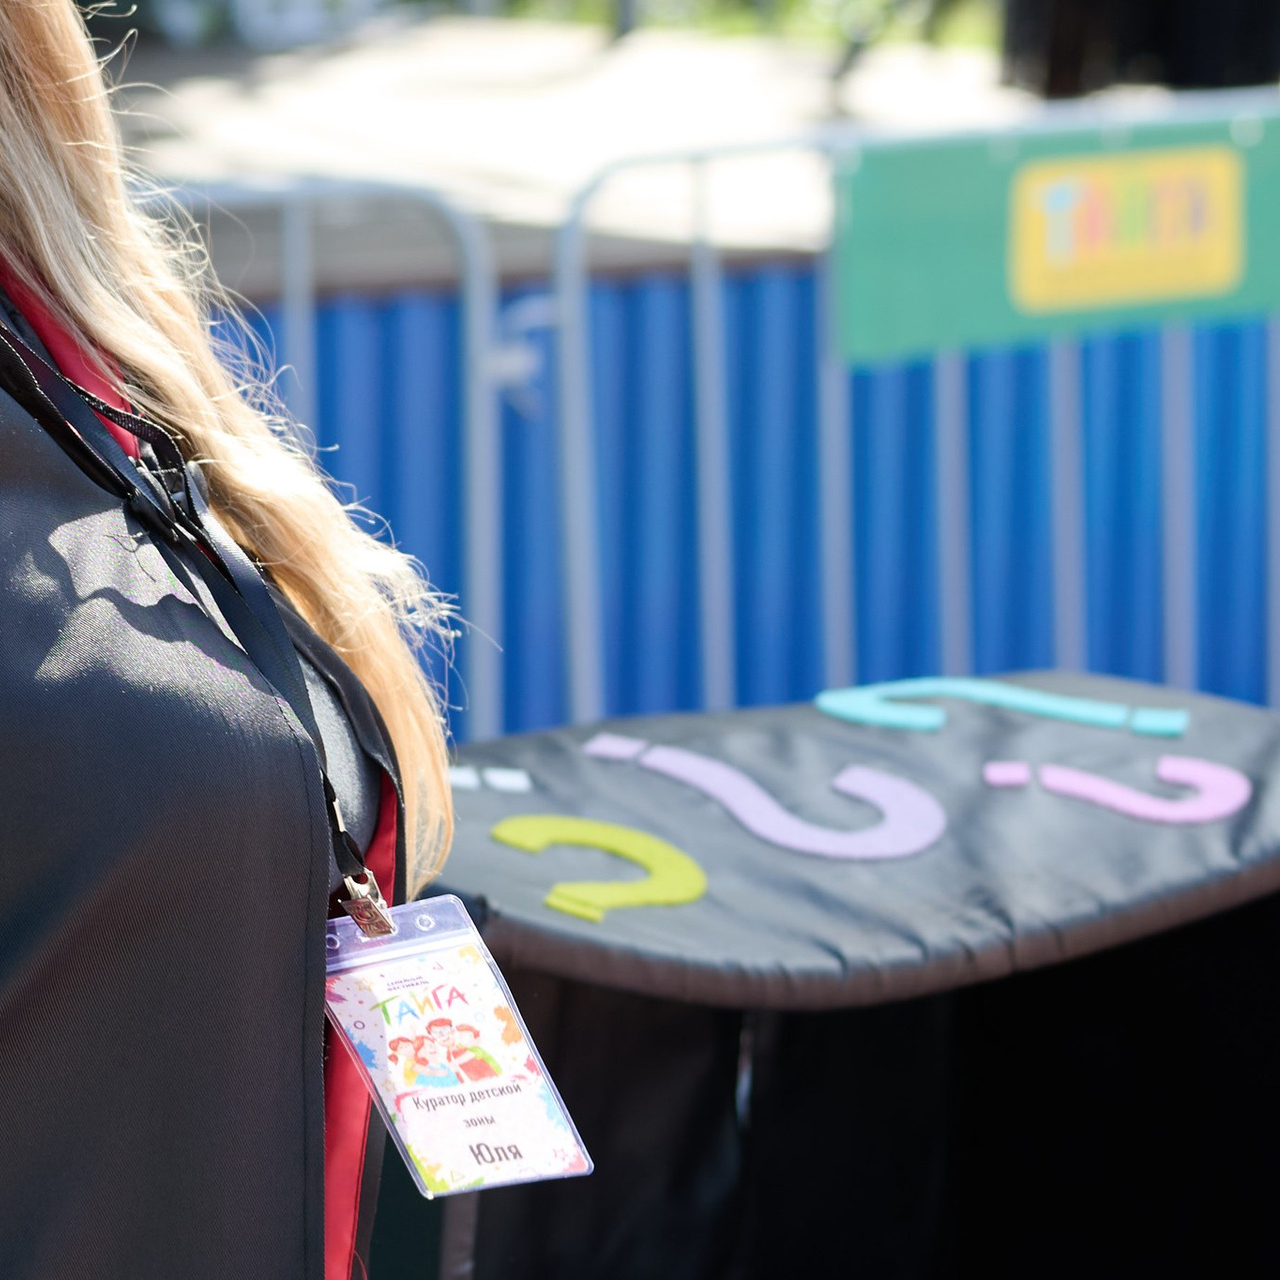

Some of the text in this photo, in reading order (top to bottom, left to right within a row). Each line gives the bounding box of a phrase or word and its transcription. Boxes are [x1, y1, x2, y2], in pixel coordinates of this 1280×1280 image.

[412, 1080, 522, 1112] Куратор детской
[463, 1116, 496, 1128] зоны
[469, 1143, 523, 1165] Юля
